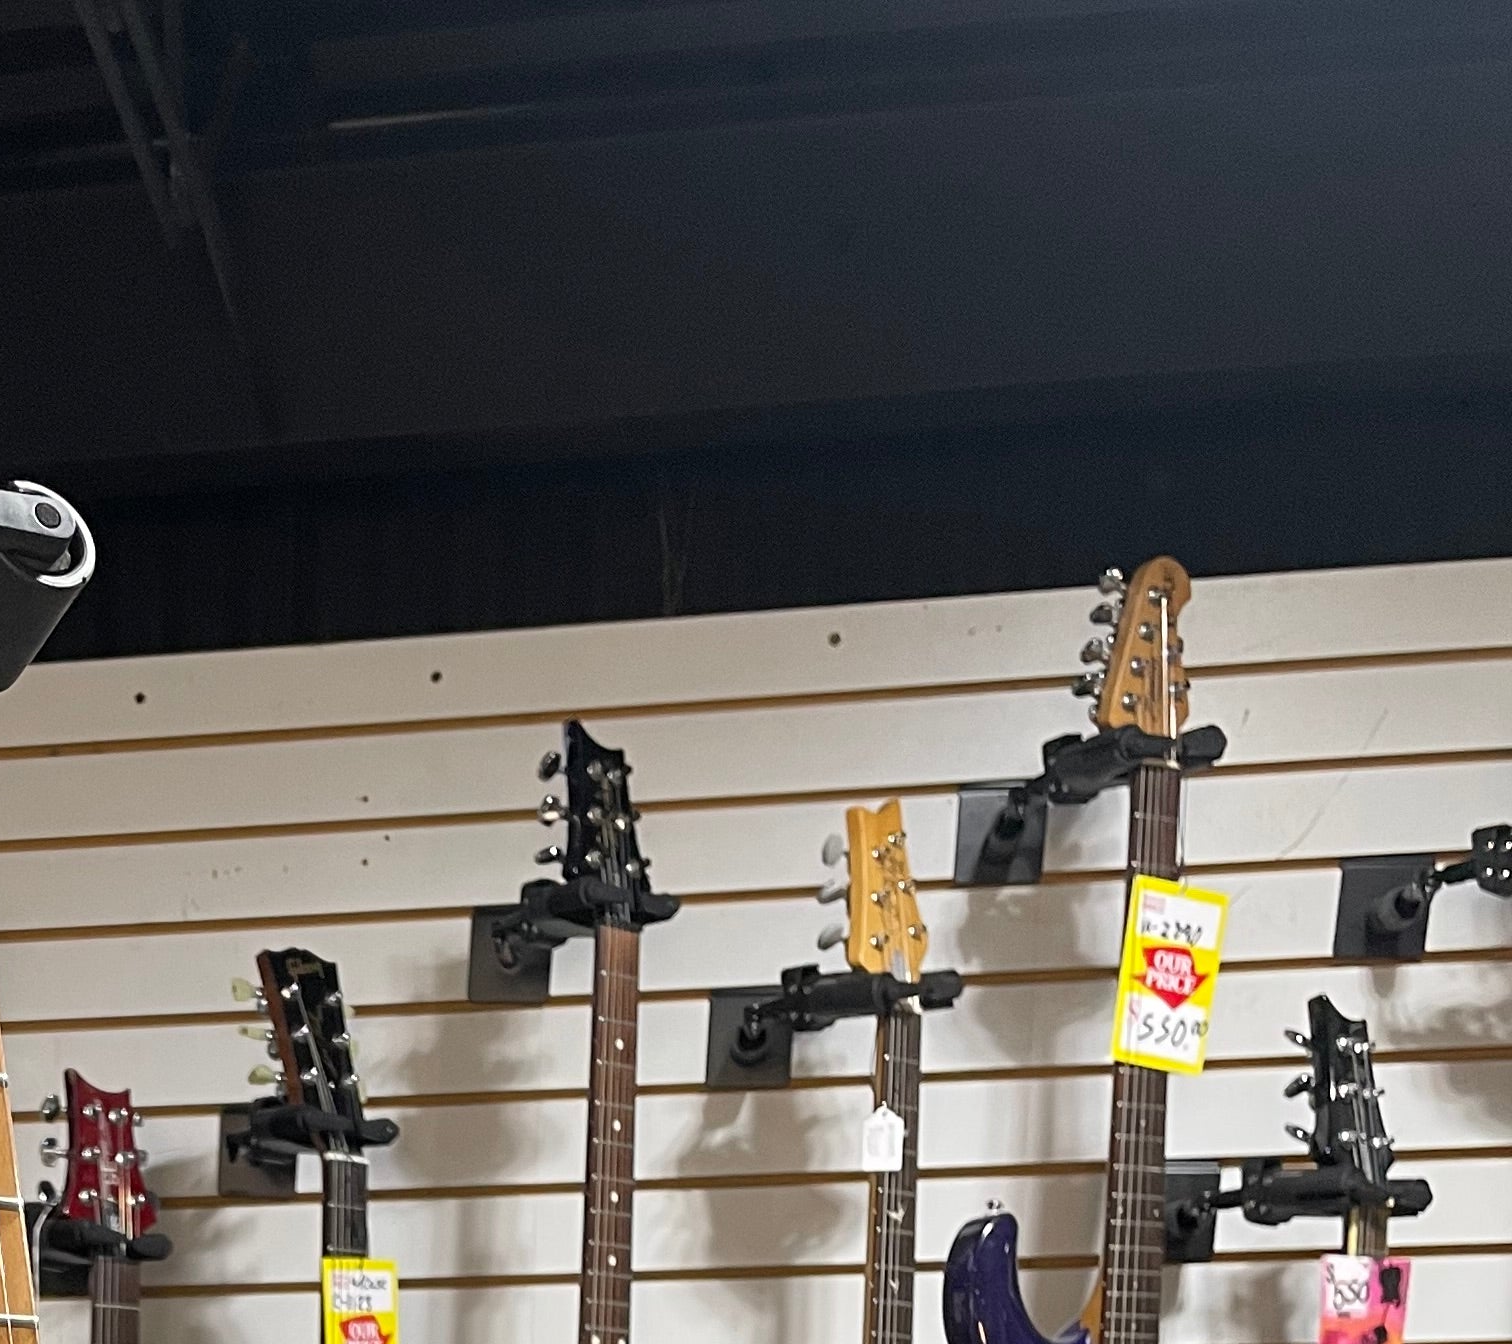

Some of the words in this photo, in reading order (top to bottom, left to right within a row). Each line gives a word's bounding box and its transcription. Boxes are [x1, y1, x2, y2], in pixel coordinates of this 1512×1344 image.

[1153, 949, 1193, 974] OUR
[1145, 968, 1198, 996] PRICE
[347, 1322, 379, 1340] OUR
